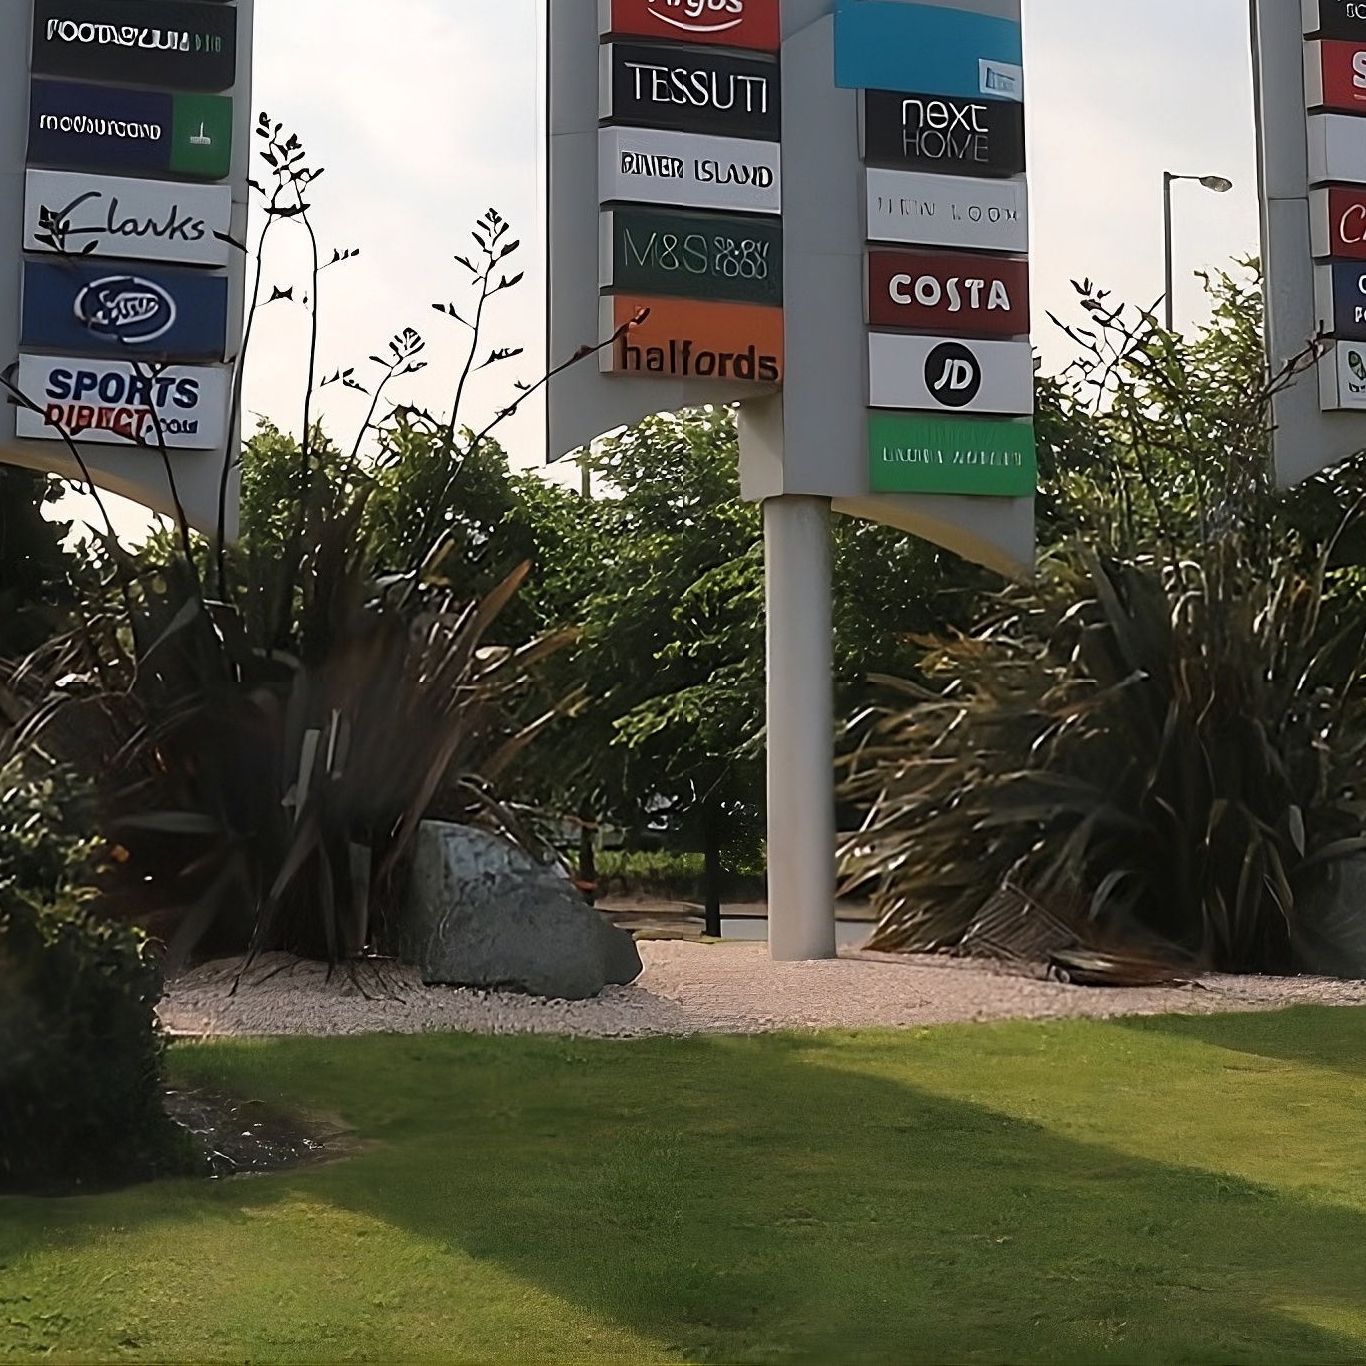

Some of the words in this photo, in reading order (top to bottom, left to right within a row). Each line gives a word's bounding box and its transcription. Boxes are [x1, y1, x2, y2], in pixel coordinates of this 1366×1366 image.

[623, 61, 768, 114] TESSUTI
[902, 98, 989, 133] next
[902, 129, 989, 163] HOME
[693, 159, 774, 189] ISLAND
[55, 190, 205, 241] Clarks
[888, 273, 1011, 312] COSTA
[620, 335, 780, 382] halfords
[933, 358, 974, 391] JD
[45, 368, 200, 409] SPORTS
